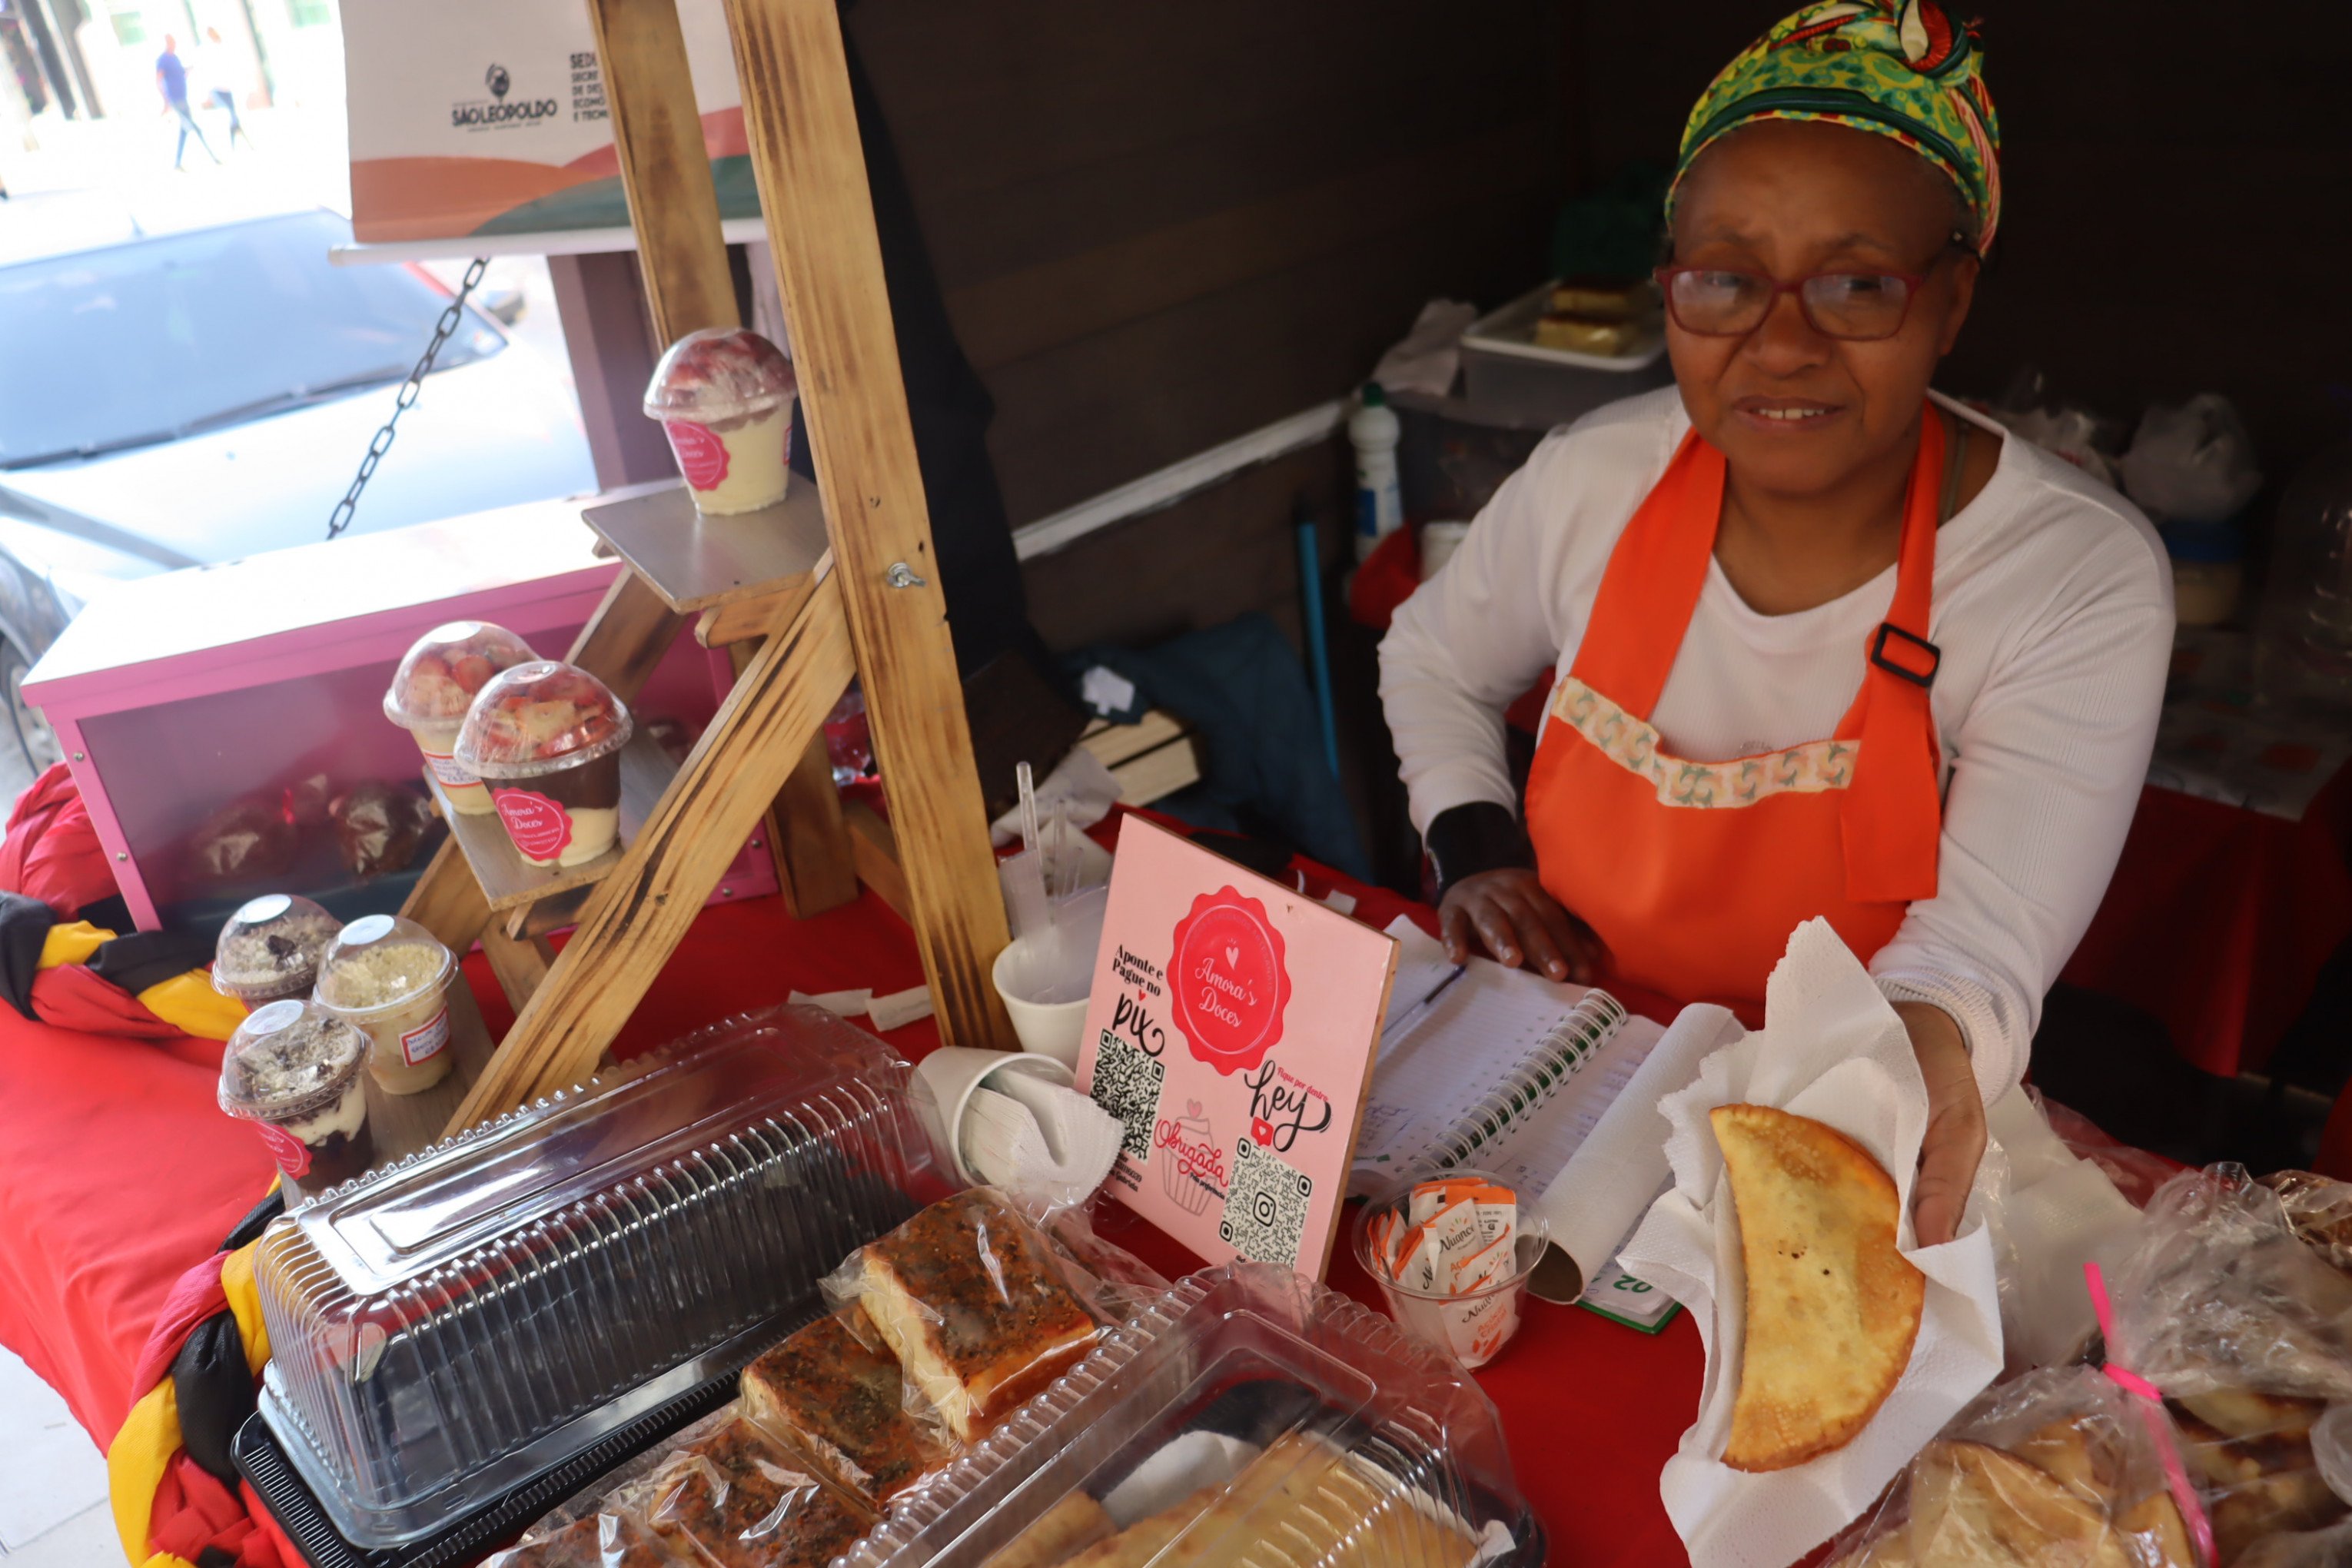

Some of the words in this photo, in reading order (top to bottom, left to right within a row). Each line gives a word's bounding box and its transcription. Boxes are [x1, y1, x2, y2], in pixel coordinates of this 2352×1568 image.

[510, 816, 543, 829] Doces
[1112, 958, 1145, 987] Pague
[1147, 978, 1161, 997] no
[1116, 944, 1154, 976] Aponte
[1156, 970, 1164, 981] e
[1194, 957, 1257, 1006] Amora's
[1198, 986, 1242, 1028] Doces
[1293, 1079, 1307, 1089] por
[1244, 1059, 1332, 1152] hey
[1154, 1118, 1229, 1188] Obrigada
